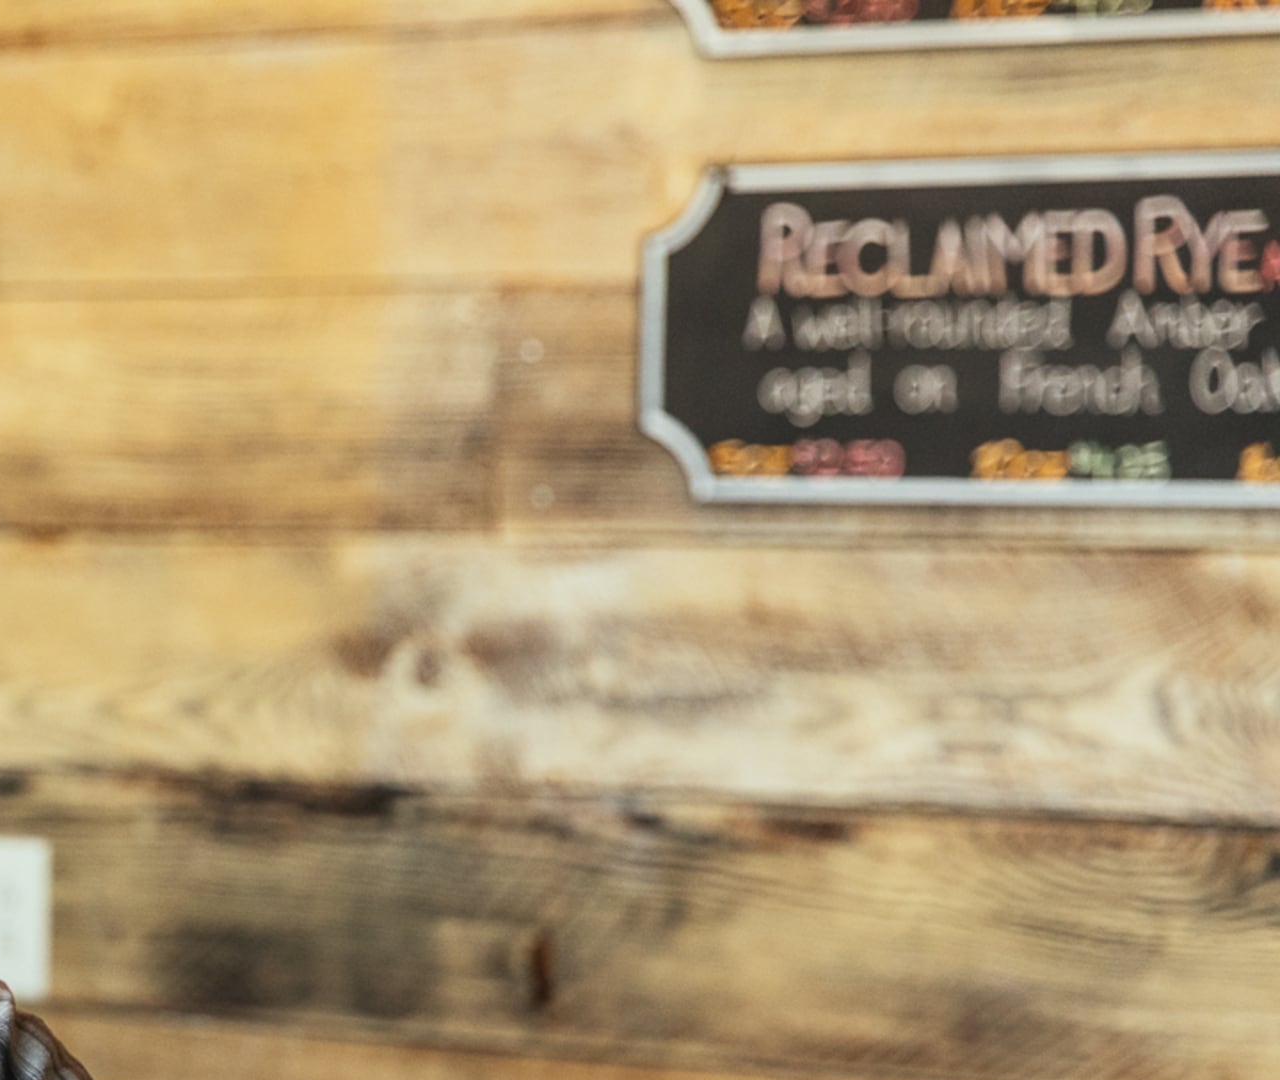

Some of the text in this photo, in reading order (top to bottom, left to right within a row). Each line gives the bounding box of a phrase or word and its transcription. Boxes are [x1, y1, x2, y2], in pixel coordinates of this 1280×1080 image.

[757, 195, 1269, 298] RECLAIMED RYE
[742, 295, 786, 351] A
[1106, 288, 1265, 351] Amber
[757, 348, 873, 428] aged
[893, 364, 959, 415] on
[998, 346, 1162, 416] French
